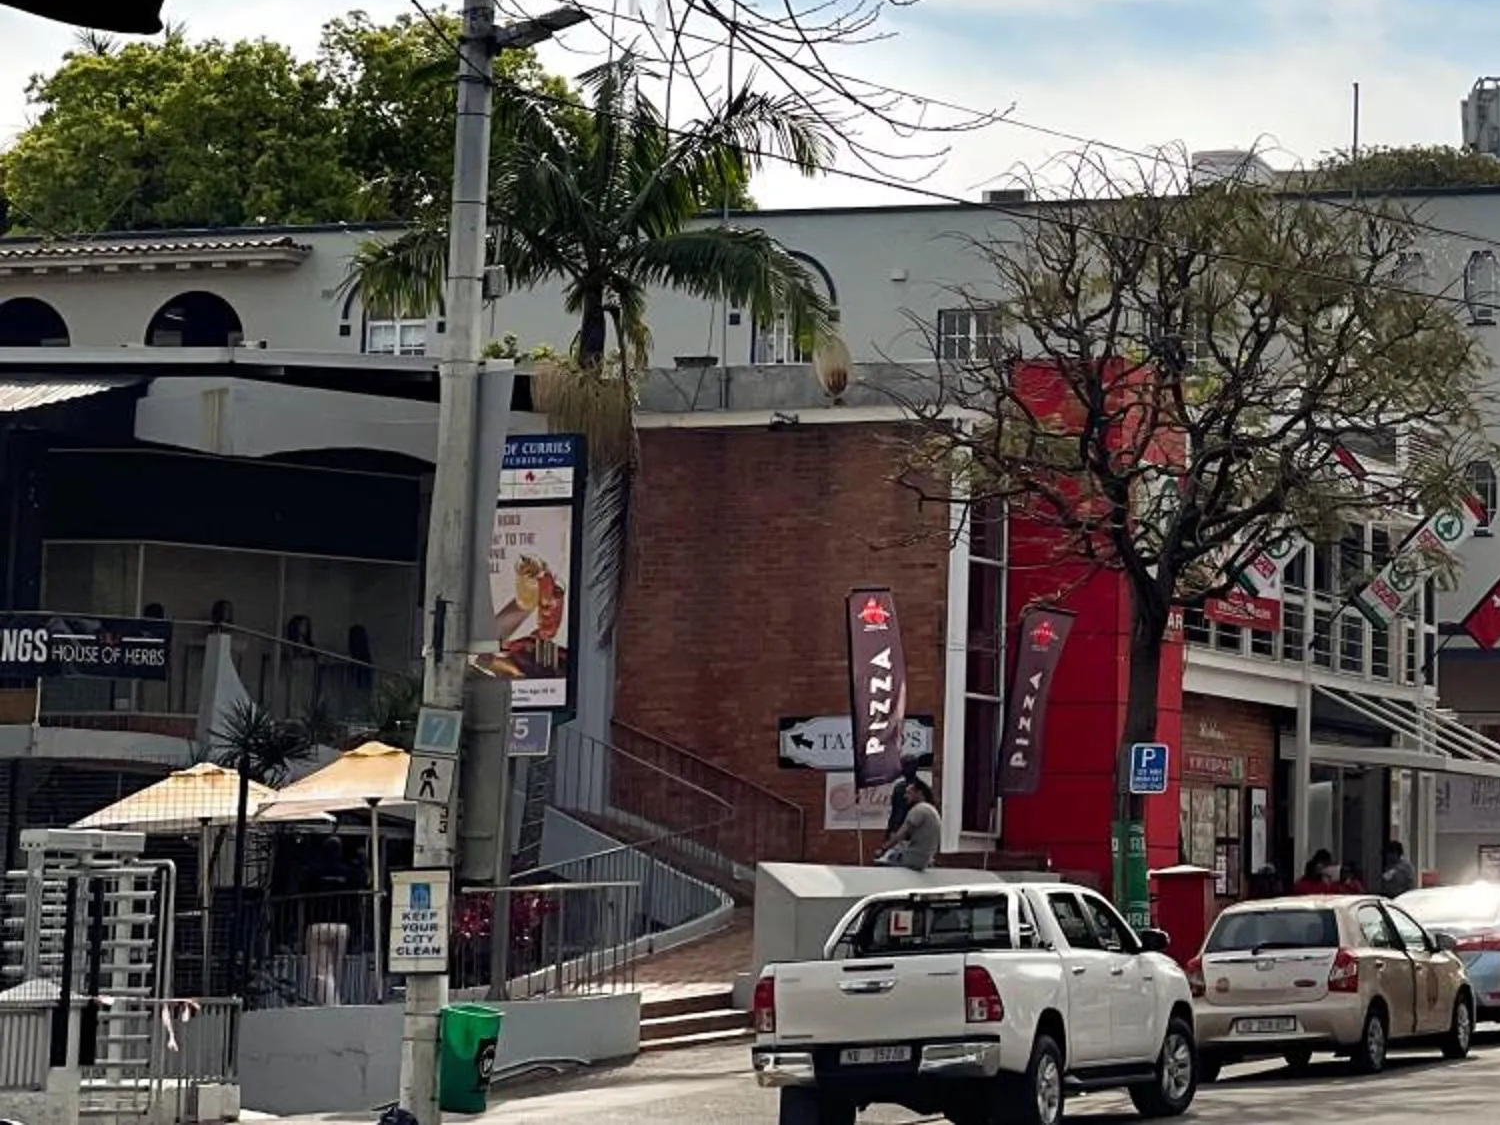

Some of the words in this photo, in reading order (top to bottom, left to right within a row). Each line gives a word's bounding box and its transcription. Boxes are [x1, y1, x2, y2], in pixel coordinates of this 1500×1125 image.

[51, 643, 98, 663] HOUSE
[101, 645, 121, 664] OF
[124, 647, 166, 666] HERBS
[865, 647, 893, 756] PIZZA
[1009, 671, 1043, 768] PIZZA
[1141, 748, 1156, 767] P
[401, 912, 439, 922] KEEP
[894, 912, 908, 931] L
[401, 922, 440, 933] YOUR
[402, 933, 436, 944] CITY
[395, 945, 442, 956] CLEAN
